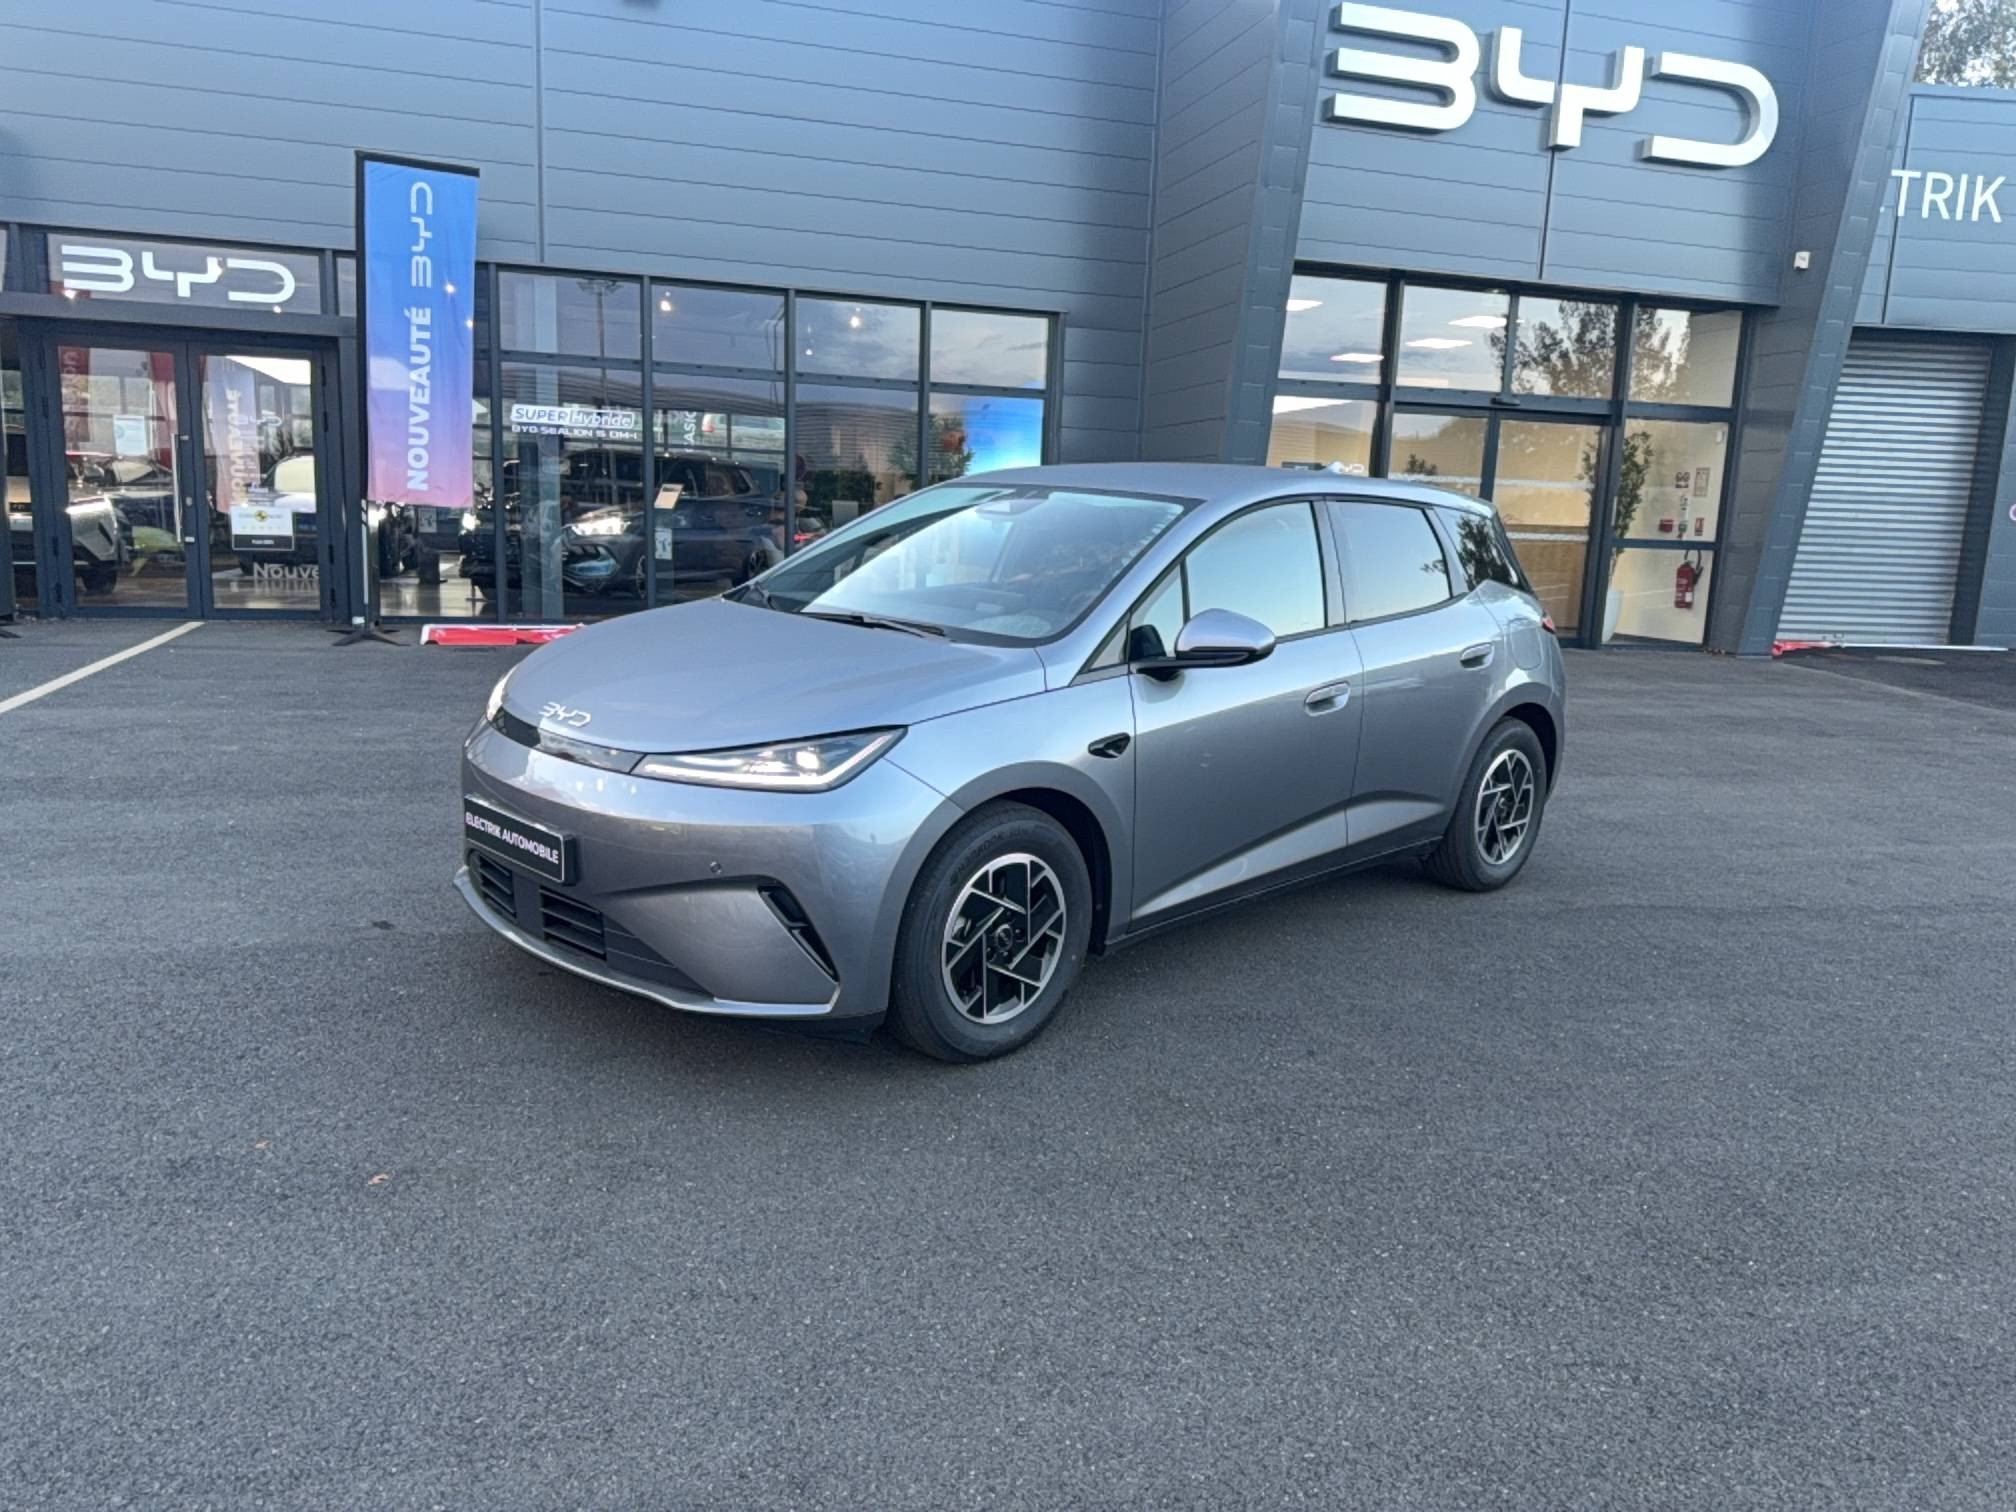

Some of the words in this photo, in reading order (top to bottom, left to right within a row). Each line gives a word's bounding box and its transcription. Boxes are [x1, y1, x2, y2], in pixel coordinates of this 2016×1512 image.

[1324, 1, 1779, 167] BYD
[1880, 169, 2007, 223] TRIK
[410, 181, 433, 288] BYD
[61, 244, 296, 303] BYD
[404, 306, 432, 491] NOUVEAUTÉ
[515, 407, 569, 425] SUPER
[571, 411, 633, 428] Hybride
[511, 424, 538, 433] BYD
[538, 701, 592, 727] BYD
[465, 811, 502, 839] ELECTRIK
[501, 829, 559, 865] AUTOMOBILE
